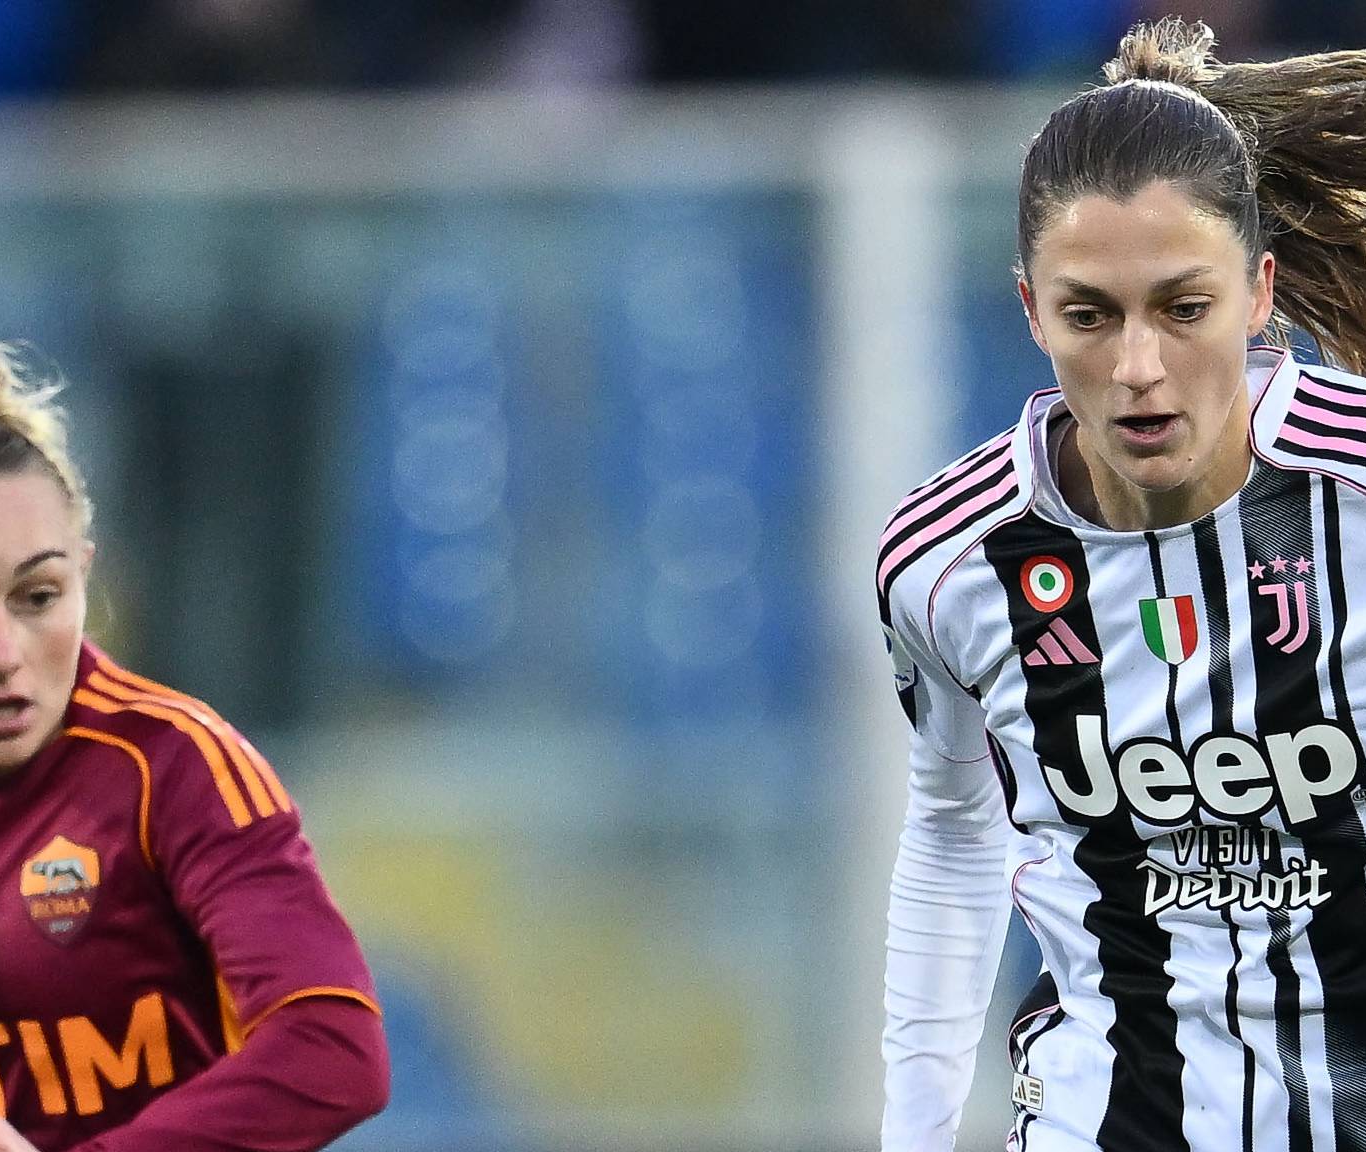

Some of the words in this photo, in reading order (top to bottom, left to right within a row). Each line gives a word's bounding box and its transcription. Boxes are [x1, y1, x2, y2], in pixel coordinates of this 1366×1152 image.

[1044, 715, 1358, 825] Jeep
[1173, 826, 1274, 864] VISIT
[1137, 856, 1332, 916] Detroit
